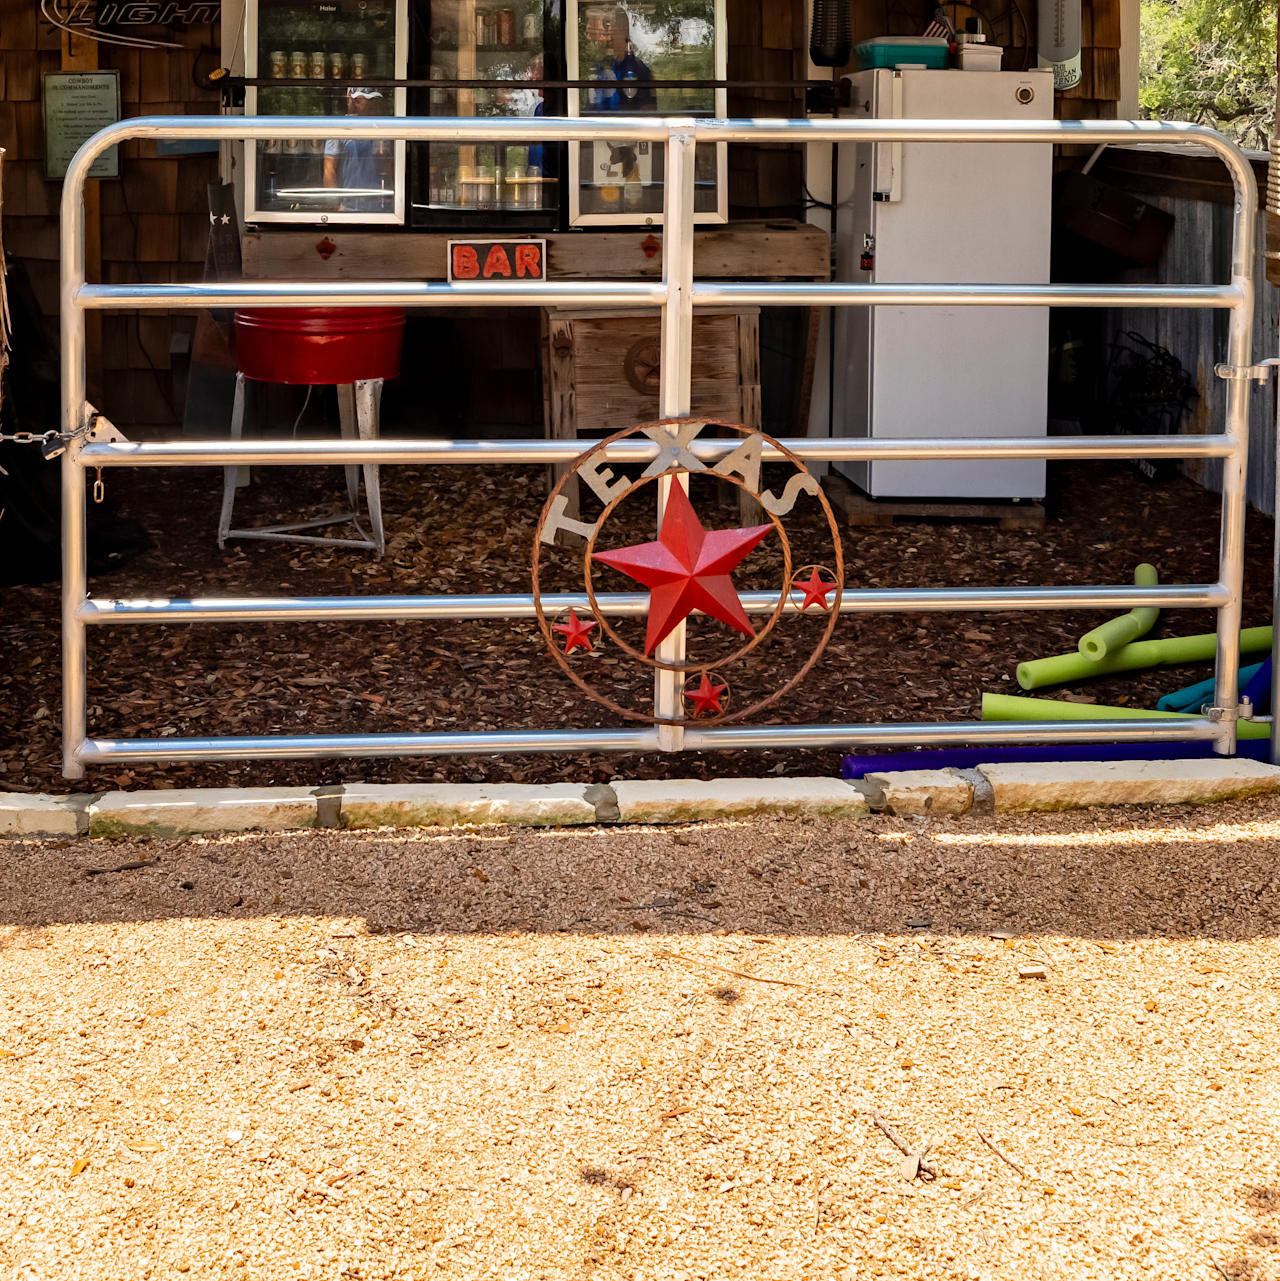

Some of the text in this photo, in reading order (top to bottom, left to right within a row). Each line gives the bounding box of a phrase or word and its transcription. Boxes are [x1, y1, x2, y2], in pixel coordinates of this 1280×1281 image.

[64, 0, 222, 26] LIGHT
[453, 244, 541, 278] BAR
[540, 422, 820, 546] TEXAS
